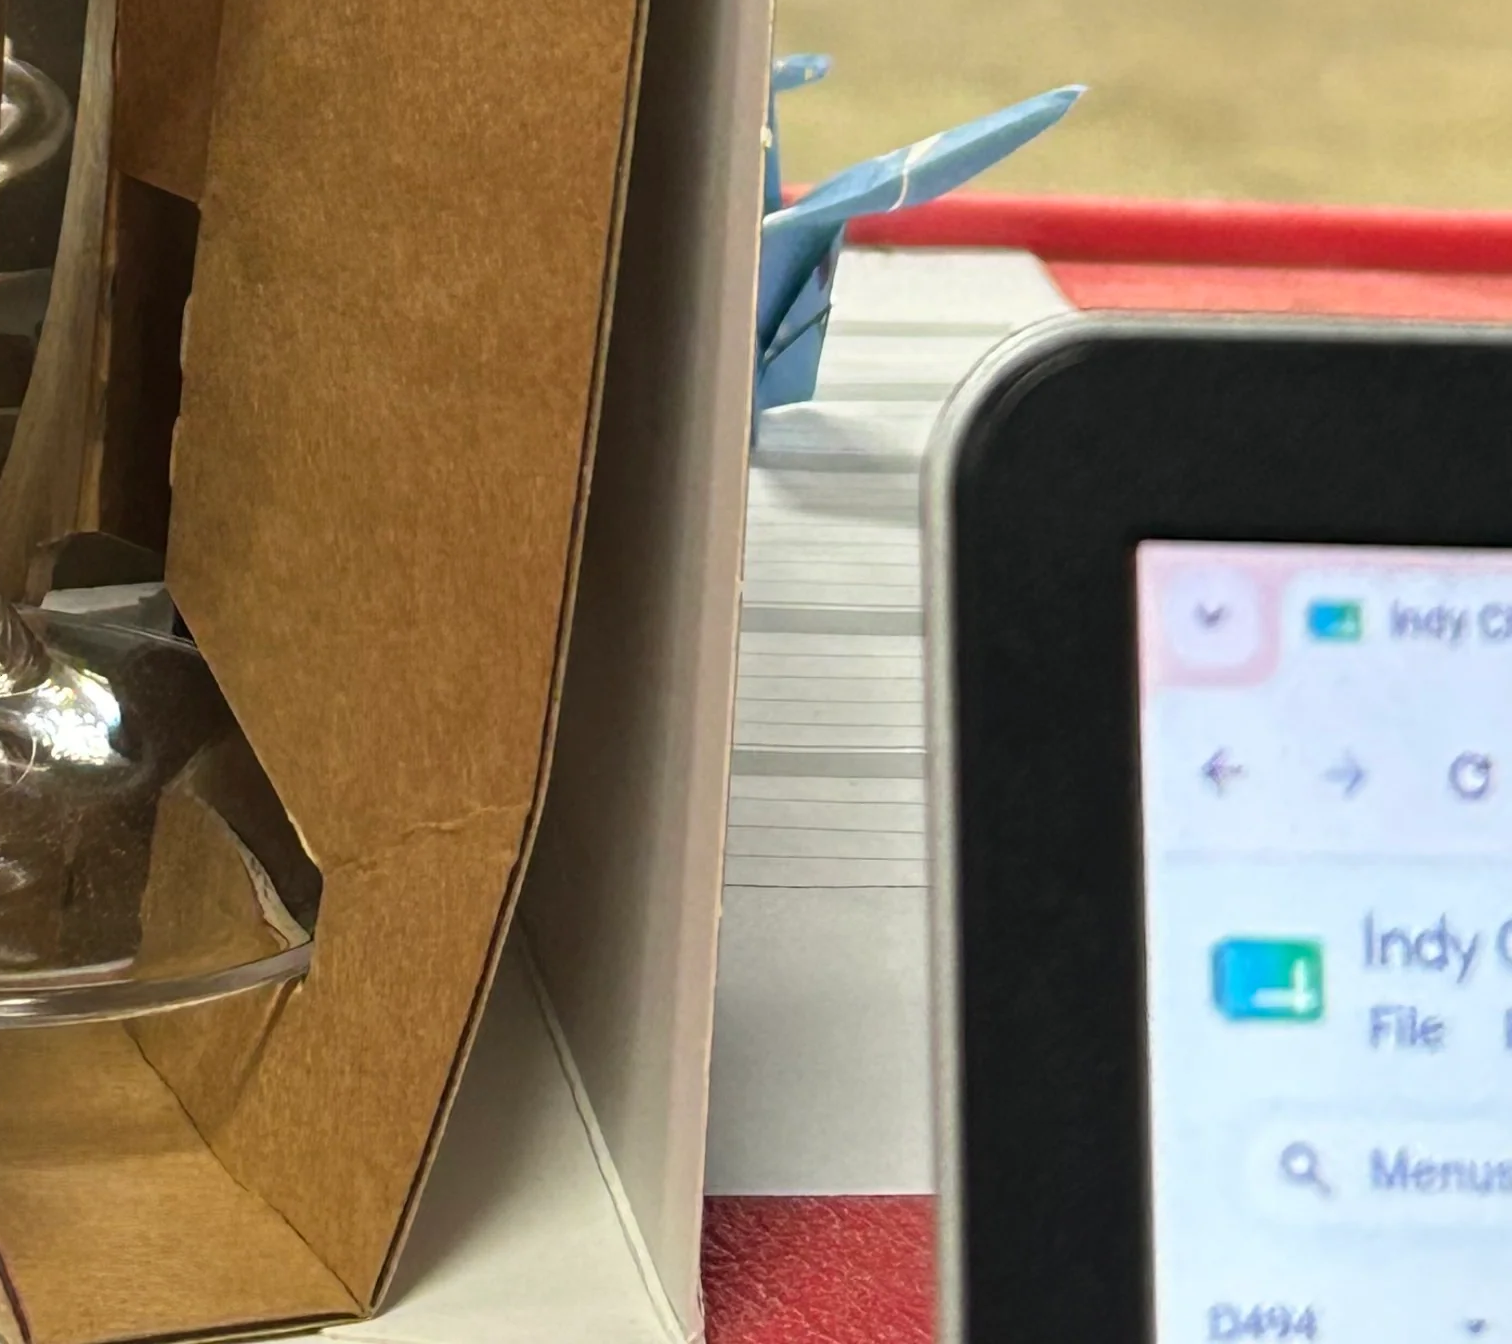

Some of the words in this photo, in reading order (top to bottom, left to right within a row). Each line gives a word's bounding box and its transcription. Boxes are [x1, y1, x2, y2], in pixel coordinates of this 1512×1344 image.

[1389, 599, 1468, 650] Indy
[1363, 912, 1479, 985] Indy
[1369, 1005, 1445, 1051] File
